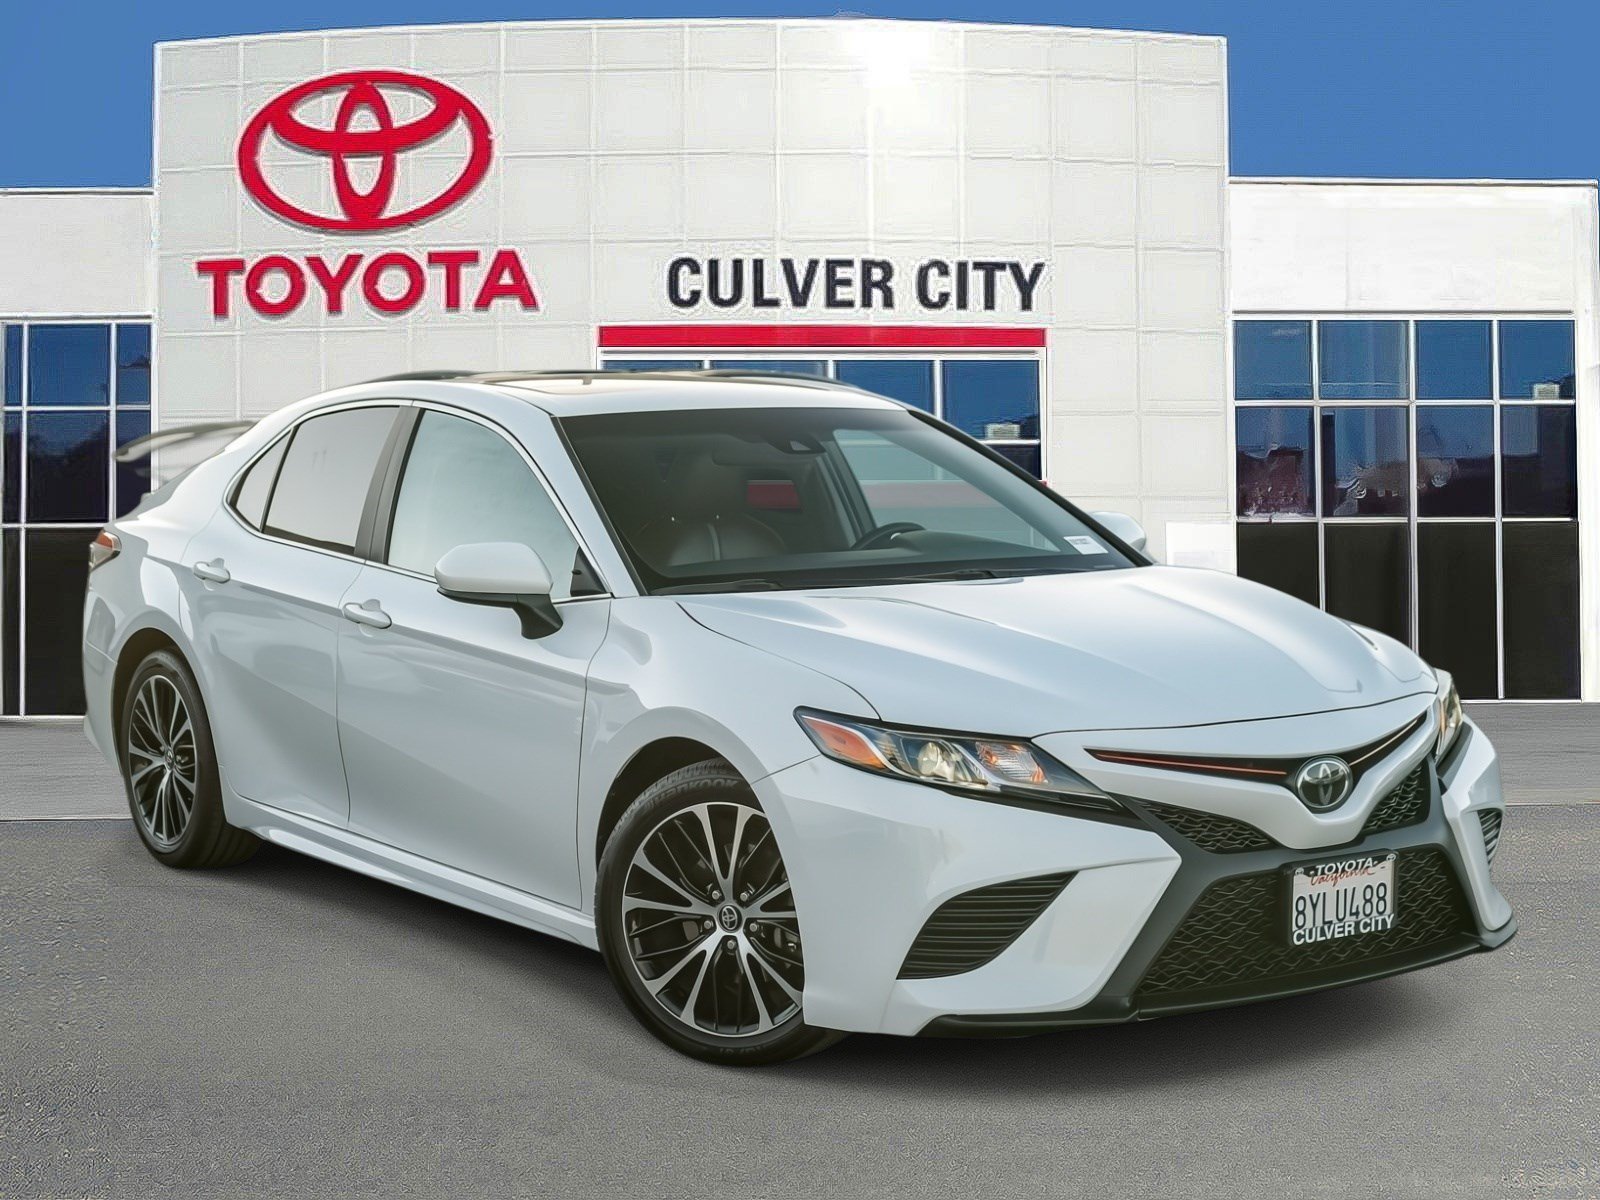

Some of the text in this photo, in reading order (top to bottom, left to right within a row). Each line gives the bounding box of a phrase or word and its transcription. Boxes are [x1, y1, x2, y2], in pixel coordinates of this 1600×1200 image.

[196, 249, 539, 318] TOYOTA
[667, 257, 1045, 311] CULVER CITY
[1315, 857, 1373, 876] TOYOTA
[1295, 882, 1387, 929] 8YLU488
[1293, 914, 1394, 945] CULVER CITY
